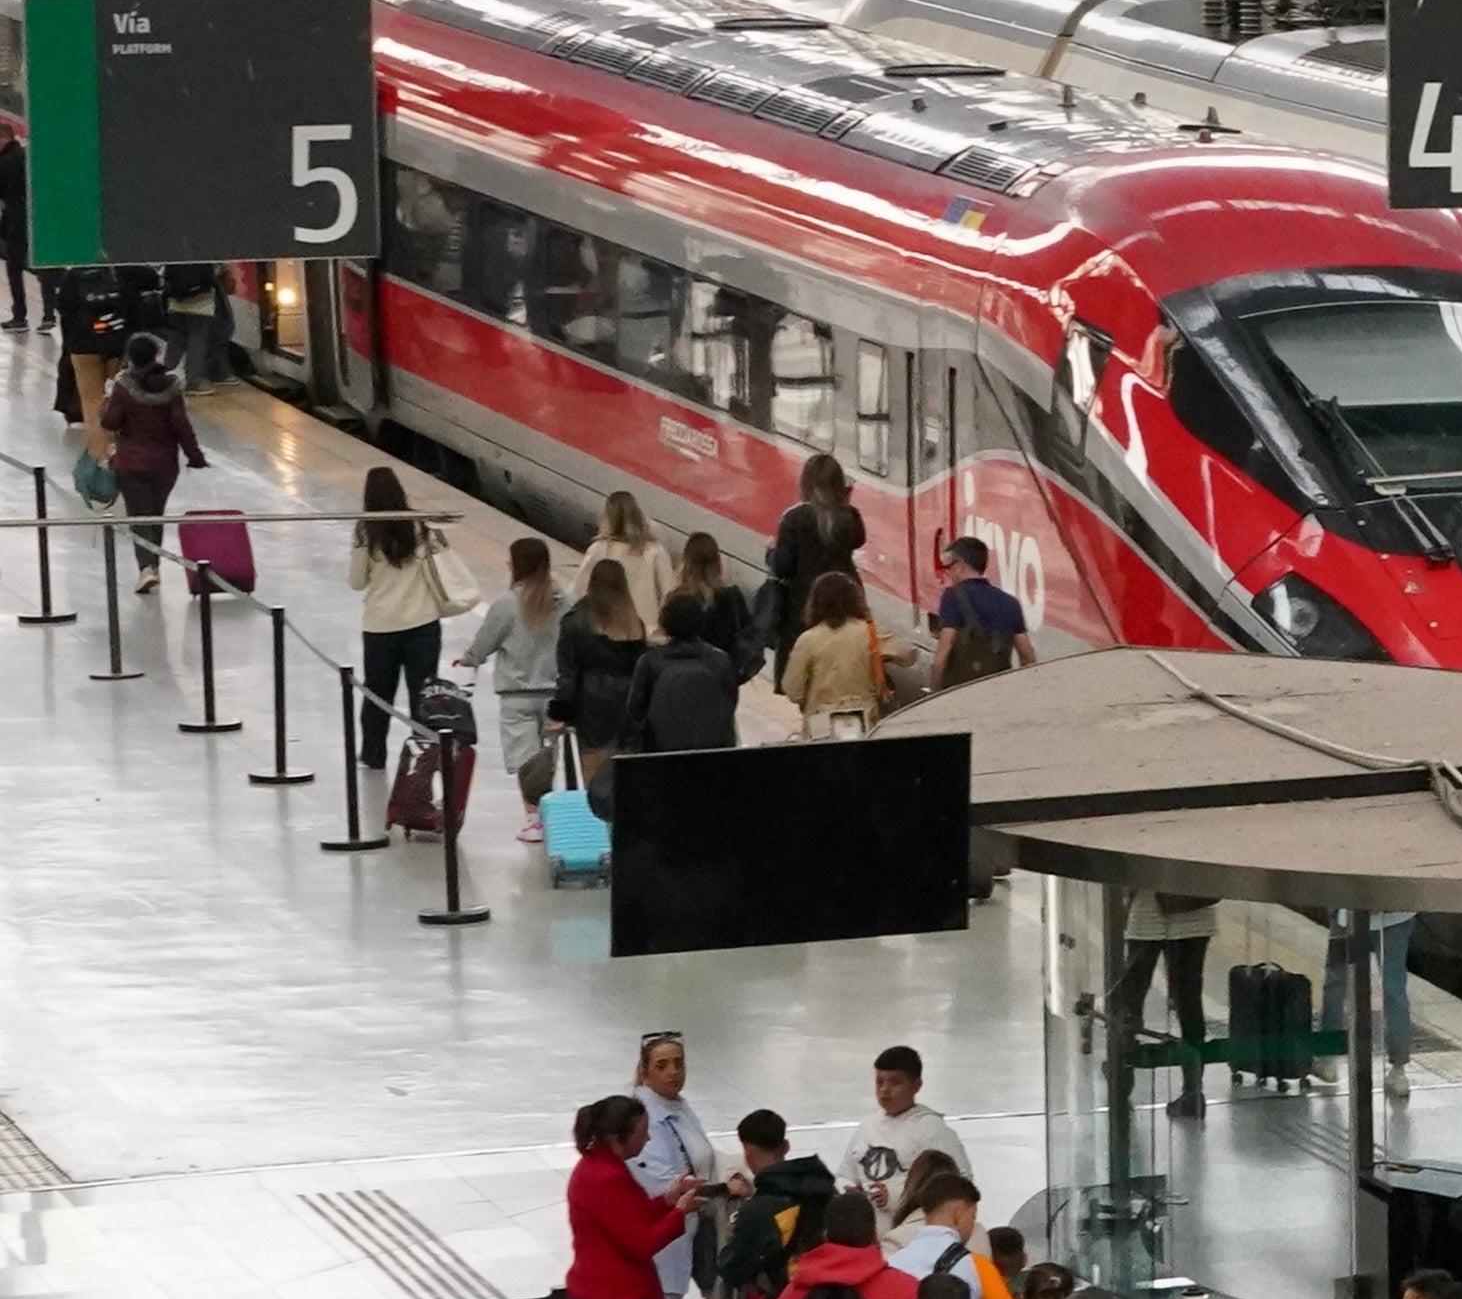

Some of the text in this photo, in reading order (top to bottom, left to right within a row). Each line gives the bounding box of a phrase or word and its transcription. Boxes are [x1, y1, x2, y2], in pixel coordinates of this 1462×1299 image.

[113, 9, 151, 34] Vía
[111, 43, 173, 56] PLATFORM
[291, 124, 359, 244] 5
